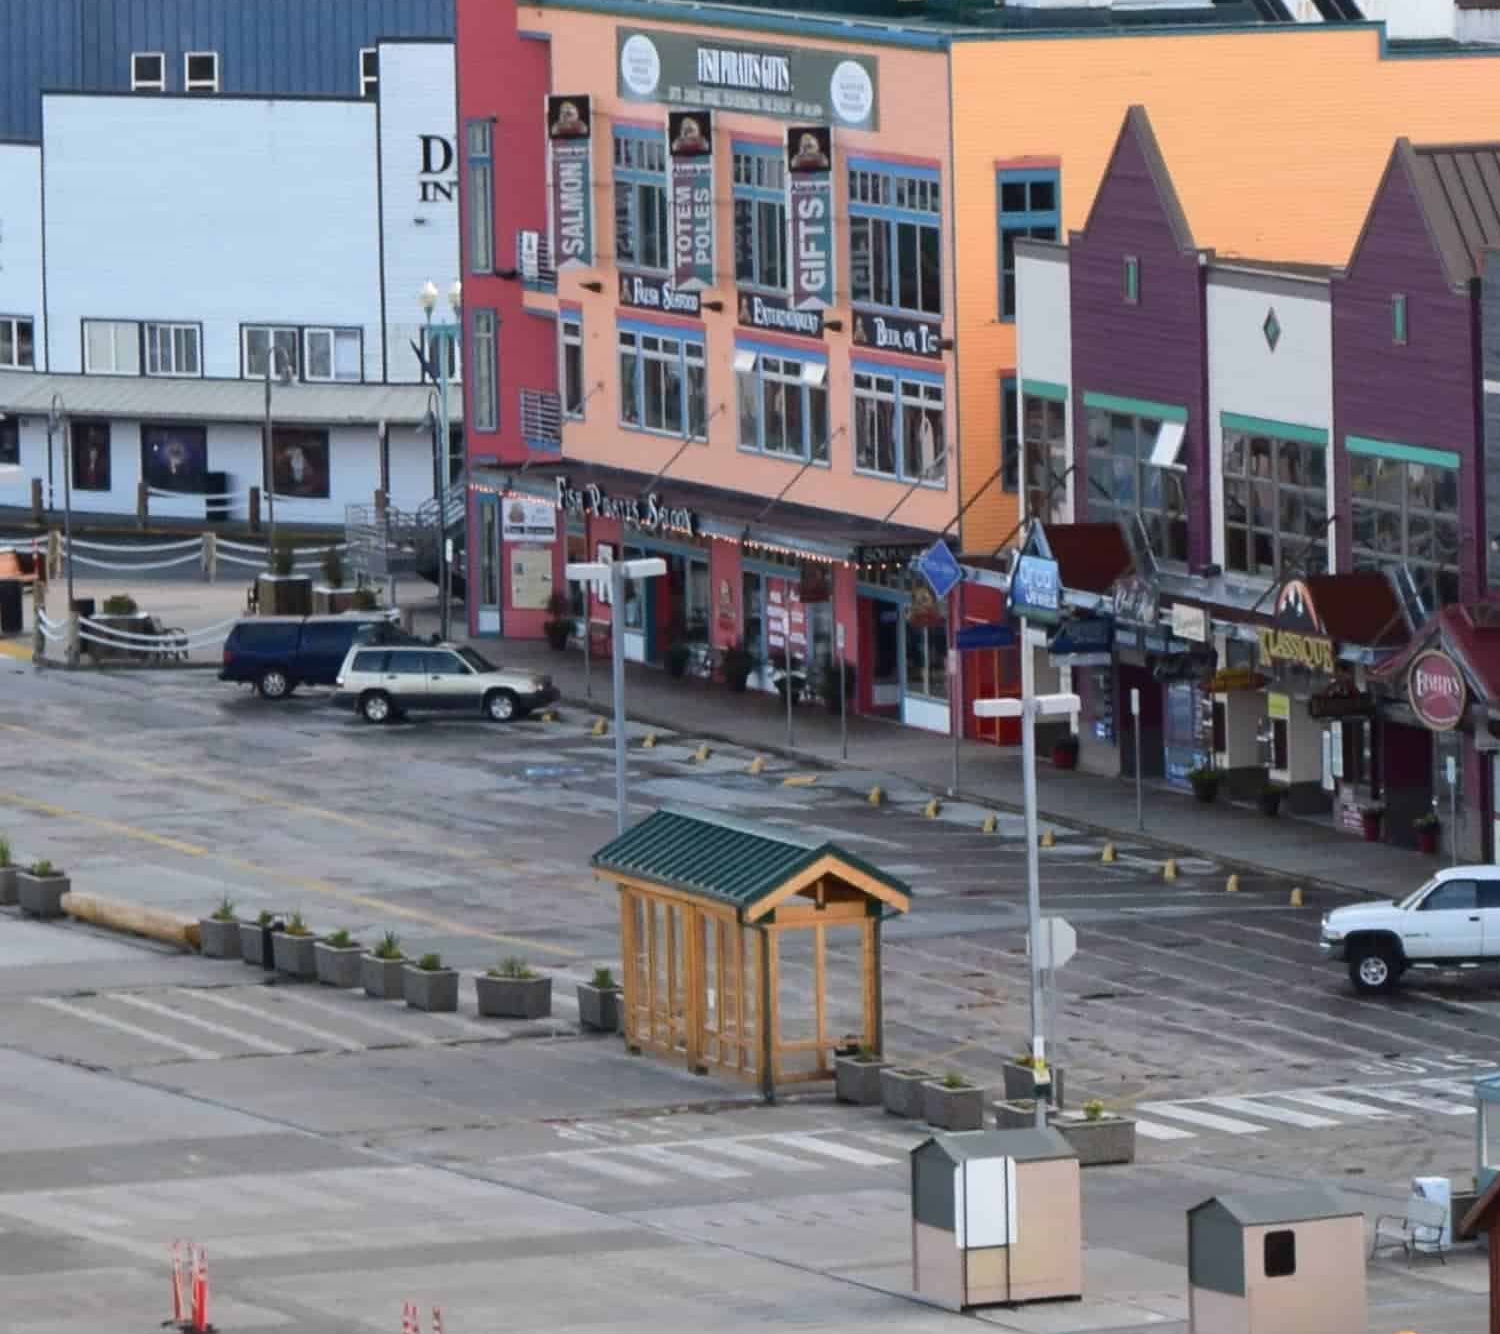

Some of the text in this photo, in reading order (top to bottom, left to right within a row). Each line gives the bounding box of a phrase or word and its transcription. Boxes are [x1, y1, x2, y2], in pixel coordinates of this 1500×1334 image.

[561, 161, 585, 255] SALMON
[675, 178, 692, 267] TOTEM
[694, 185, 712, 266] POLES
[801, 196, 825, 292] GIFTS
